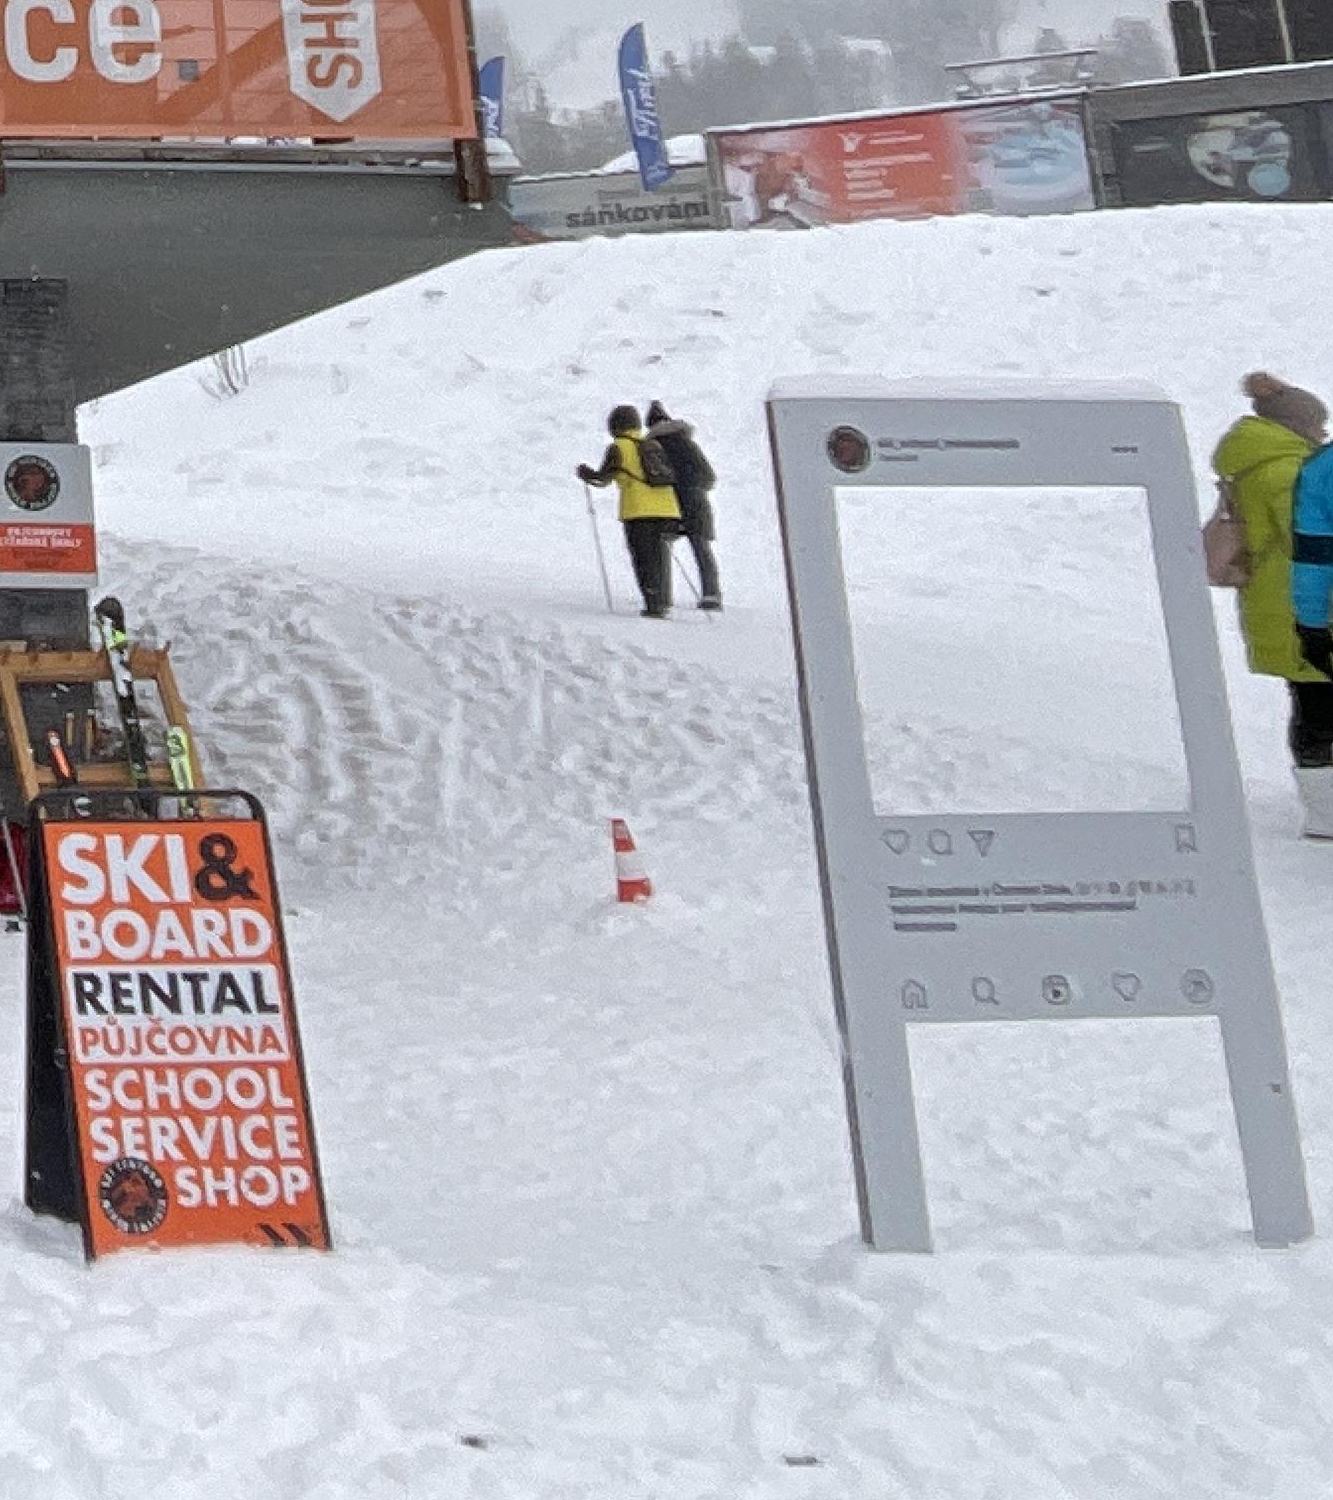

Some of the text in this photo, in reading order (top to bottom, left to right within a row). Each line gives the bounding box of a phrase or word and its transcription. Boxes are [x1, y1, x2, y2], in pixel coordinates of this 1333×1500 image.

[64, 908, 273, 960] BOARD
[73, 971, 280, 1015] RENTAL
[78, 1017, 285, 1057] PŮJČOVNA
[84, 1068, 294, 1112] SCHOOL
[90, 1115, 303, 1163] SERVICE
[174, 1166, 312, 1207] SHOP
